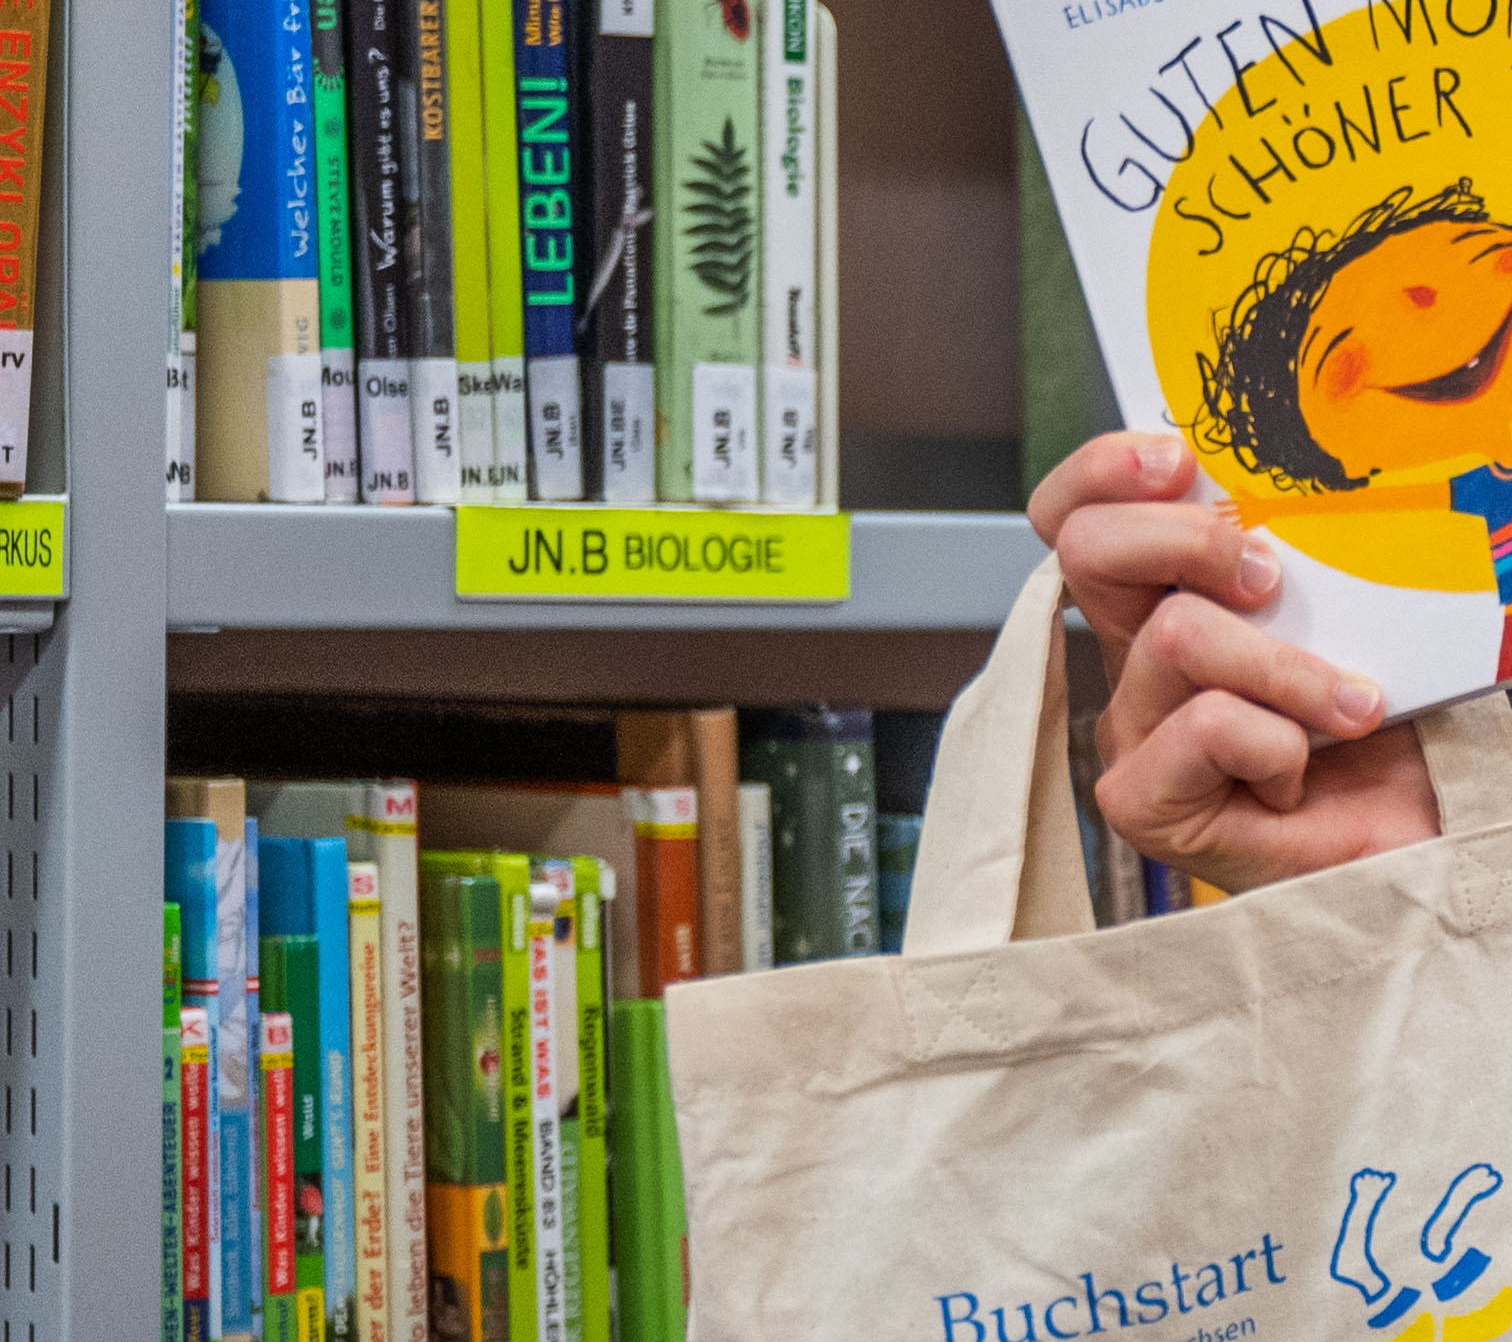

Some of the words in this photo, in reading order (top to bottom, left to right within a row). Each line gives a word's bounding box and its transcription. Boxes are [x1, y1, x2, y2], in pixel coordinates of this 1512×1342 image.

[284, 49, 307, 107] Bär
[419, 0, 444, 141] KOSTBARER
[780, 76, 806, 198] Biologie
[1173, 66, 1474, 258] SCHÖNER
[520, 76, 575, 306] LEBEN!
[371, 179, 398, 272] Warum
[301, 399, 317, 461] JN.B
[433, 397, 451, 458] JN.B
[367, 472, 409, 493] JN.B
[508, 529, 609, 576] JN.B
[624, 533, 787, 574] BIOLOGIE
[397, 919, 418, 1000] Welt?
[402, 1006, 421, 1110] unserer
[536, 1037, 553, 1098] WAS
[403, 1116, 422, 1183] Tiere
[404, 1190, 423, 1233] die
[364, 1269, 383, 1311] der
[405, 1240, 425, 1317] leben
